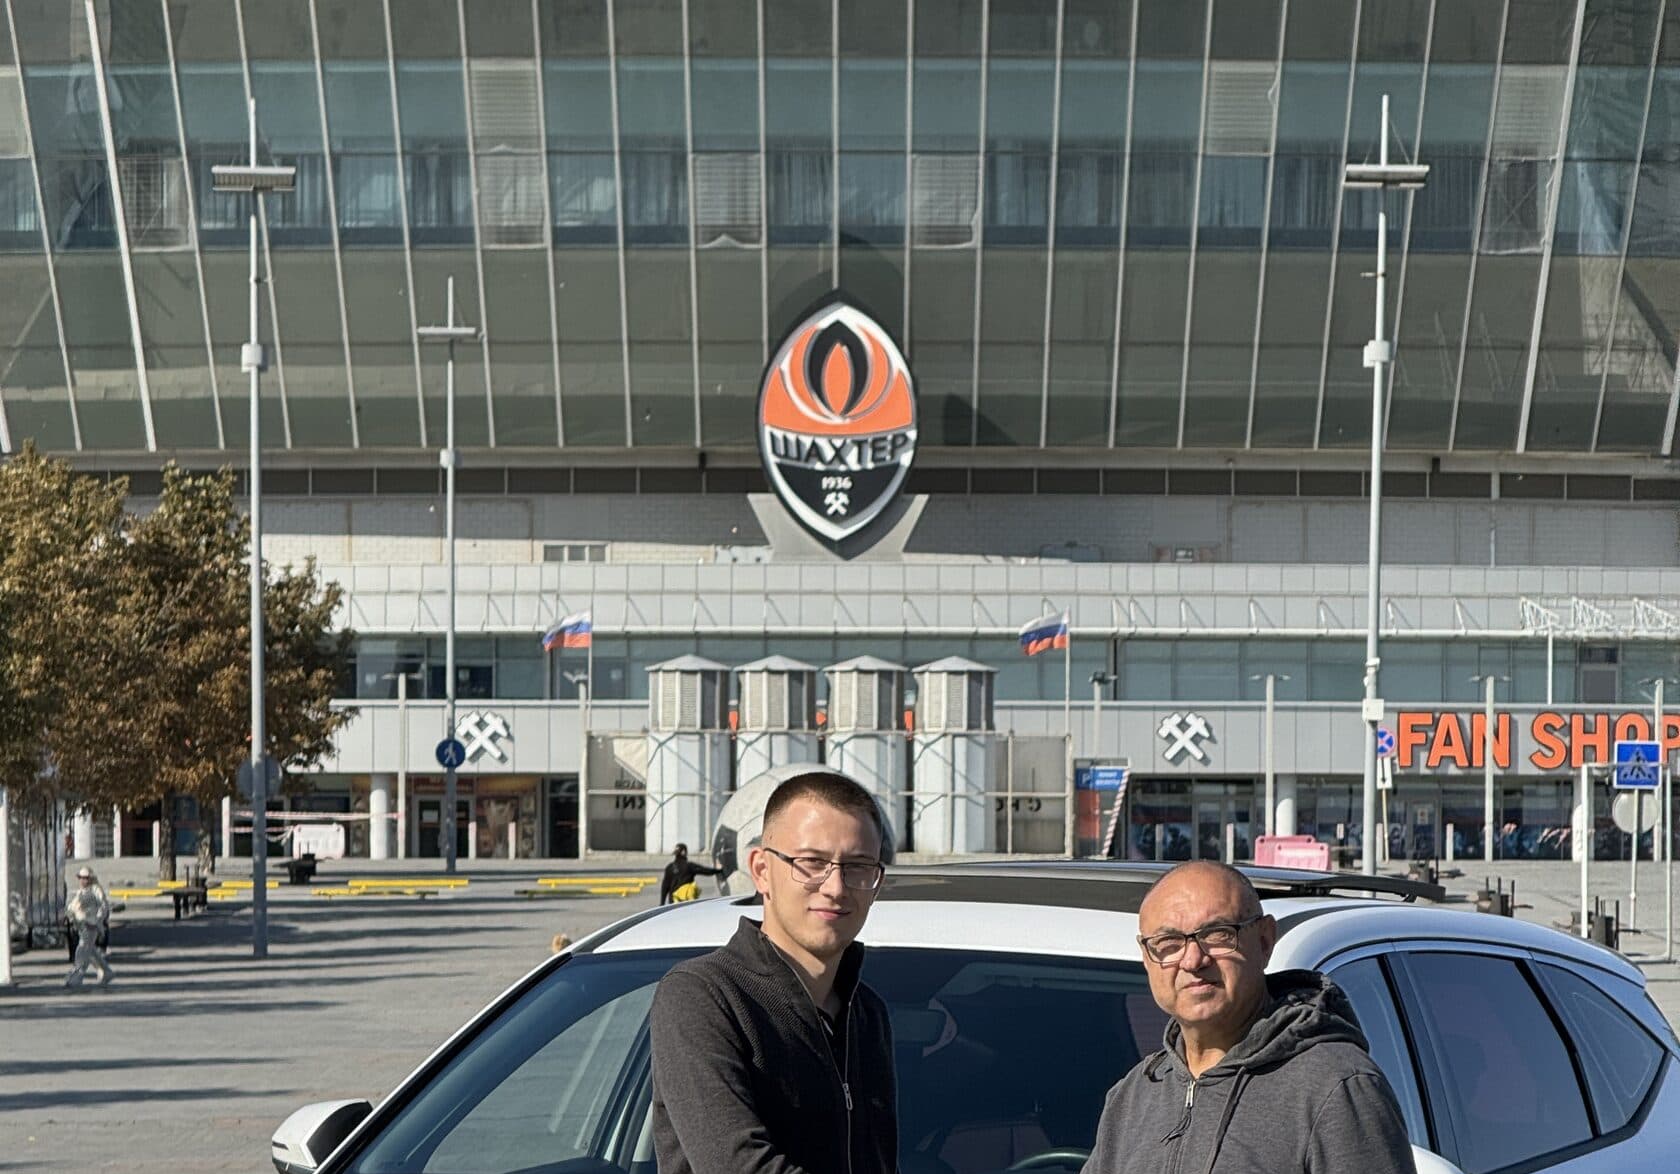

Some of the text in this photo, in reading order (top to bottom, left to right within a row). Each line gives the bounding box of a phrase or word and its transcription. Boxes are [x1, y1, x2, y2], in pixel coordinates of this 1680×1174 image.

[770, 431, 908, 466] ШАХТЕР
[821, 477, 852, 490] 1936
[1398, 712, 1511, 769] FAN
